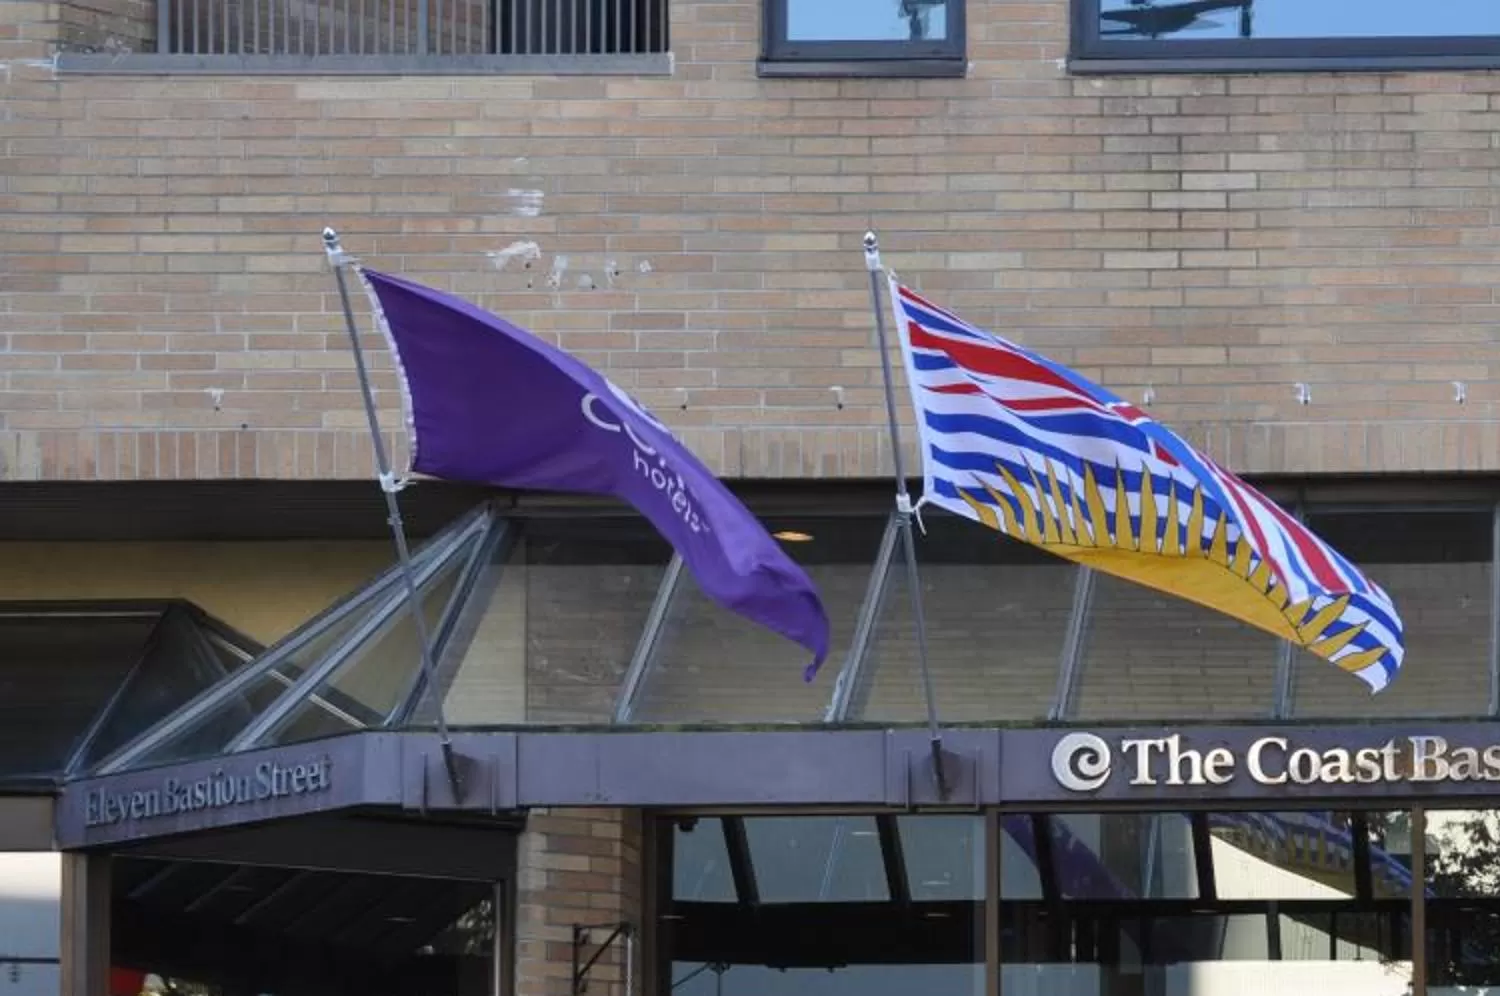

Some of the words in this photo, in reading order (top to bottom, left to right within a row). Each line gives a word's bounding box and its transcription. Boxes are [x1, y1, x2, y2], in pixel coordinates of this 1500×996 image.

[85, 788, 161, 826] Eleven
[165, 768, 249, 814] Bastion
[255, 753, 333, 799] Street
[1121, 734, 1235, 785] The
[1247, 736, 1401, 785] Coast
